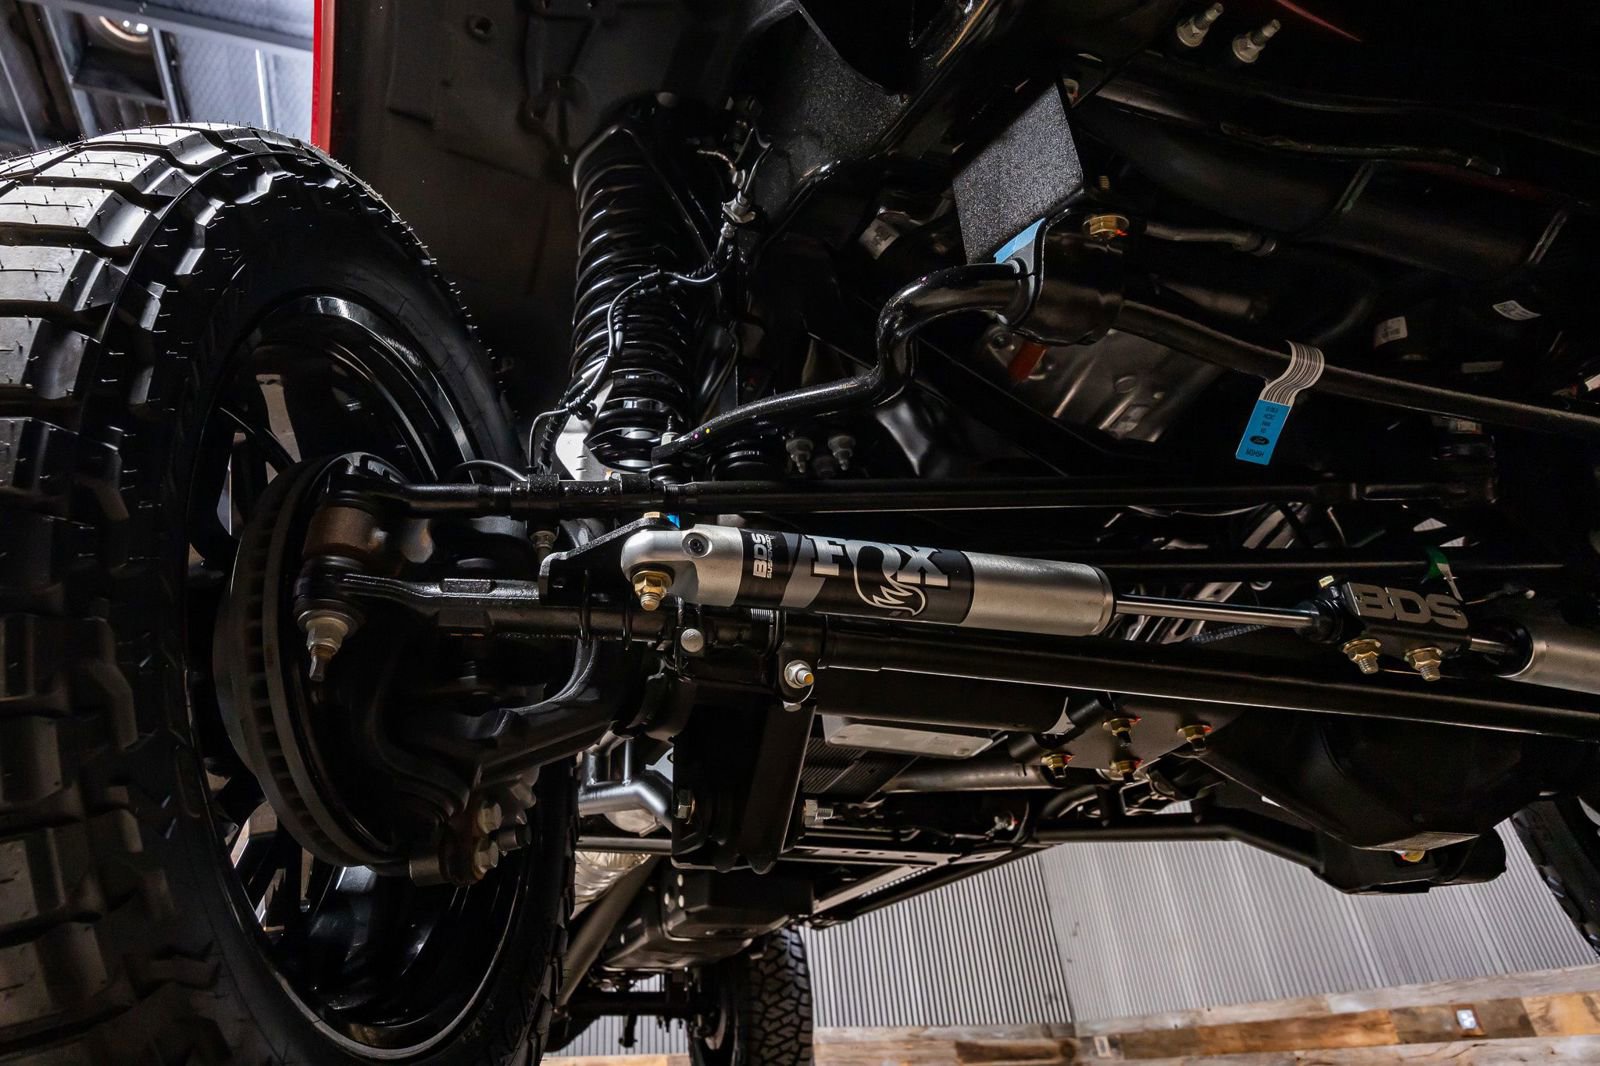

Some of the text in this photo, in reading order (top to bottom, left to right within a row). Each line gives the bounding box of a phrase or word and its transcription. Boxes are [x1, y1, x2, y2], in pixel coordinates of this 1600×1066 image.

[751, 533, 767, 578] BDS
[805, 535, 949, 615] FOX
[1348, 582, 1469, 629] BDS
